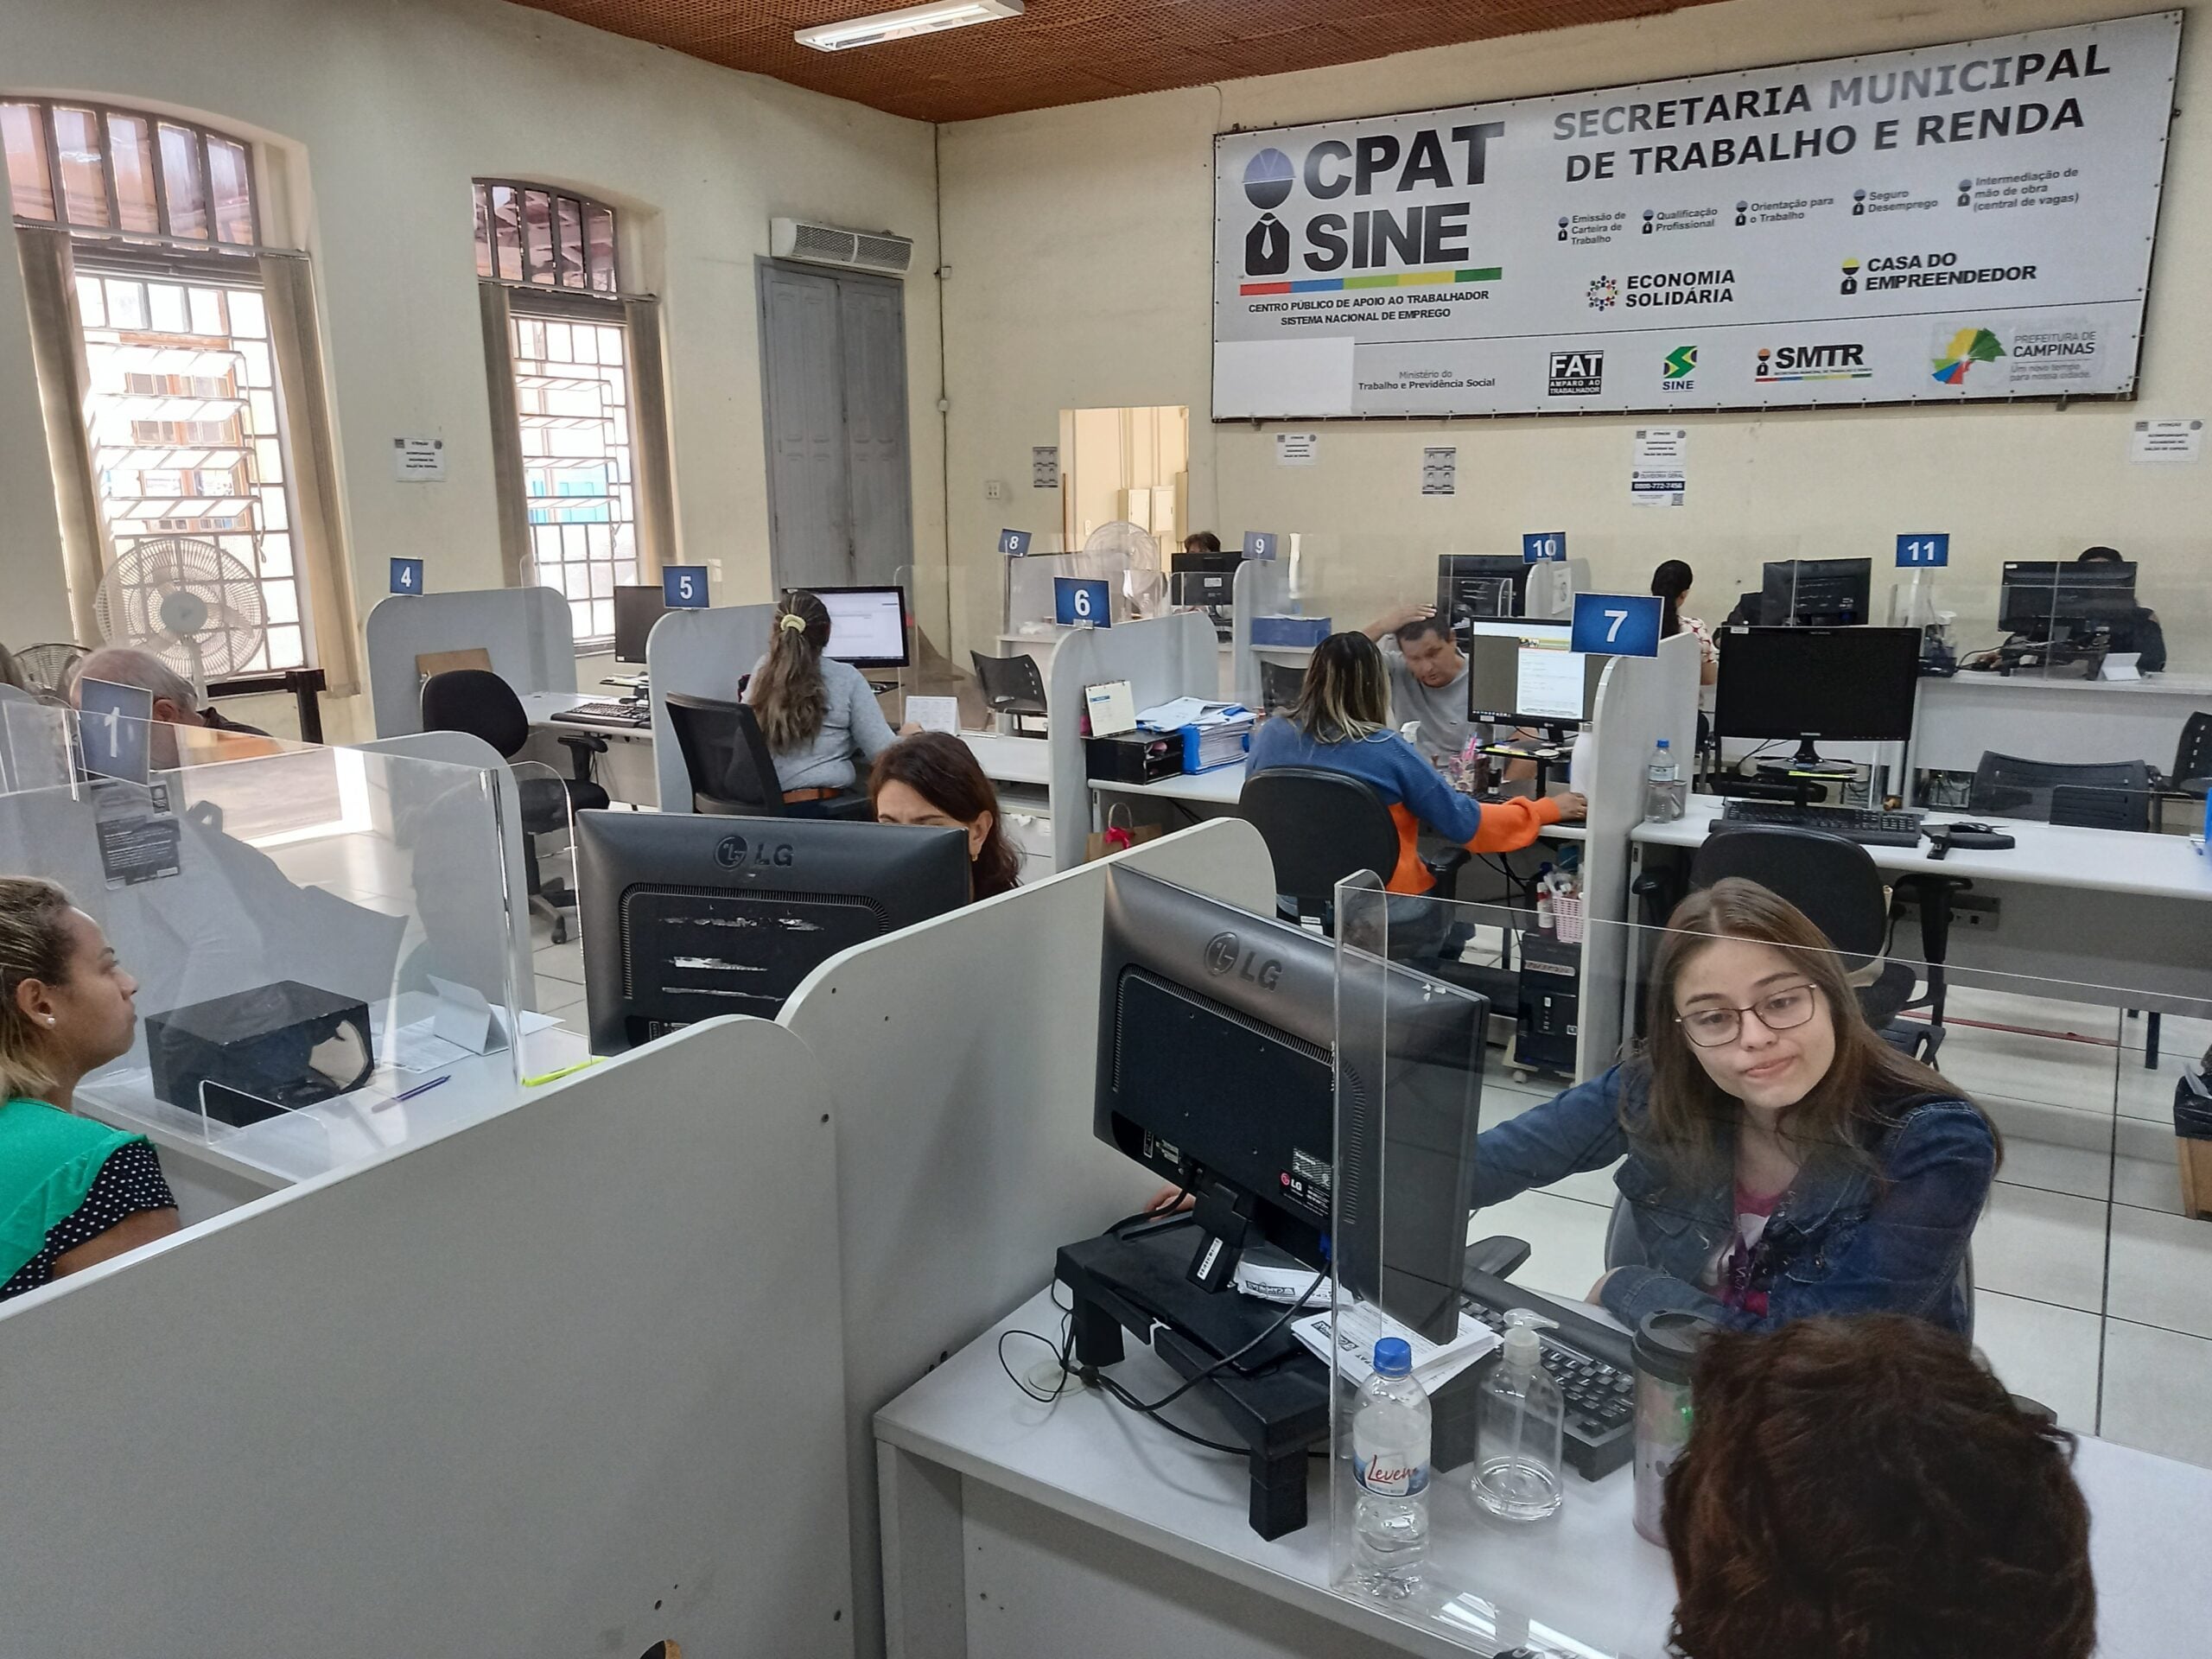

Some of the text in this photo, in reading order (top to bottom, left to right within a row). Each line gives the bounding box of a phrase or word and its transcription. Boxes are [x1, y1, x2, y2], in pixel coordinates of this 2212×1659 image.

[1554, 44, 2111, 141] SECRETARIA MUNICIPAL
[1566, 98, 2085, 182] DE TRABALHO E RENDA
[1303, 121, 1505, 200] CPAT
[1975, 168, 2078, 187] Intermediação de
[1869, 190, 1909, 201] Seguro
[1974, 184, 2048, 199] mão de obra
[1751, 197, 1834, 212] Orientação para
[1868, 200, 1938, 213] Desemprego
[1974, 192, 2079, 213] (central de vagas)
[1572, 212, 1626, 224] Emissão de
[1656, 207, 1718, 221] Qualificação
[1760, 211, 1805, 222] Trabalho
[1571, 222, 1622, 234] Carteira de
[1656, 219, 1715, 232] Profissional
[1302, 202, 1471, 272] SINE
[1571, 234, 1611, 245] Trabalho
[1867, 252, 1957, 272] CASA DO
[1627, 270, 1735, 289] ECONOMIA
[1866, 265, 2037, 290] EMPREENDEDOR
[1249, 290, 1490, 313] CENTRO PÚBLICO DE APOIO AO TRABALHADOR
[1625, 287, 1734, 308] SOLIDÁRIA
[1281, 308, 1452, 326] SISTEMA NACIONAL DE EMPREGO
[2014, 332, 2096, 343] PREFEITURA DE
[1775, 344, 1864, 369] SMTR
[2013, 342, 2095, 357] CAMPINAS
[1399, 369, 1452, 379] Ministério do
[1551, 354, 1602, 378] FAT
[1358, 381, 1399, 390] Trabalho
[1409, 378, 1464, 389] Previdência
[1466, 378, 1495, 387] Social
[1662, 380, 1694, 391] SINE
[1008, 536, 1020, 550] 8
[1255, 537, 1266, 555] 9
[1532, 539, 1557, 557] 10
[1907, 541, 1936, 561] 11
[400, 566, 412, 588] 4
[679, 575, 693, 600] 5
[1074, 589, 1091, 616] 6
[1604, 609, 1628, 643] 7
[104, 706, 120, 758] 1
[754, 844, 793, 867] LG
[1239, 950, 1283, 991] LG
